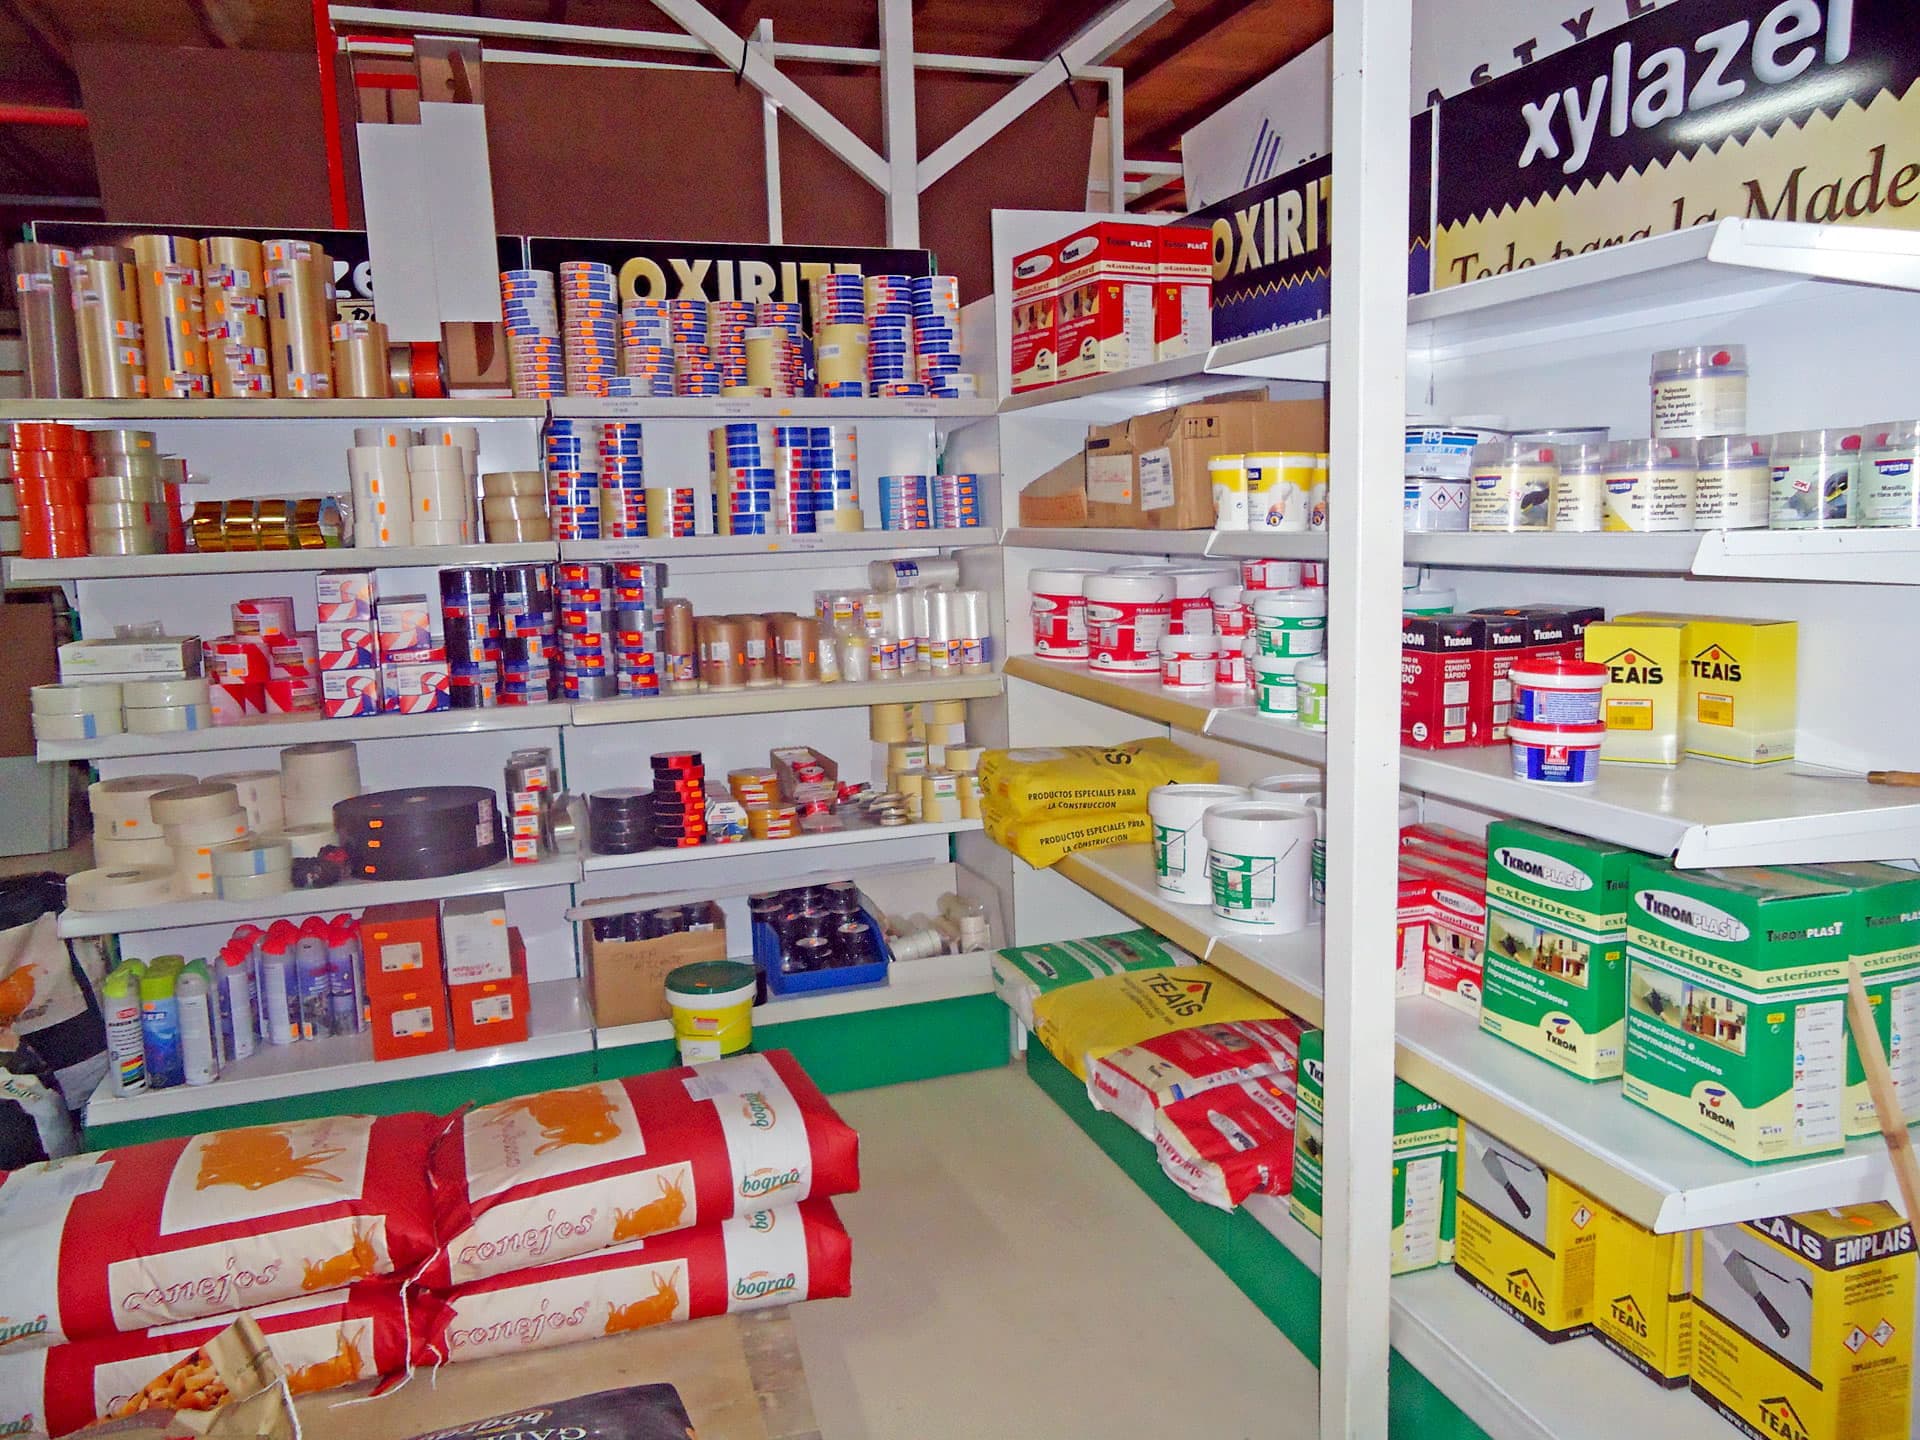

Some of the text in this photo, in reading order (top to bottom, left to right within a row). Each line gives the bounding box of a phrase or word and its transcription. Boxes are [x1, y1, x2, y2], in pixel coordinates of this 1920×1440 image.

[1518, 0, 1852, 174] xylazel
[1444, 663, 1472, 673] CEMENTO
[1691, 660, 1742, 682] TEAIS
[1028, 788, 1137, 801] PRODUCTOS ESPECIALES PARA
[1058, 801, 1117, 810] CONSTRUCCION
[1040, 819, 1145, 846] PRODUCTOS ESPECIALES PARA
[1073, 833, 1128, 850] CONSTRUCCION
[1502, 849, 1586, 890] TKROMPLAST
[1496, 884, 1587, 923] exteriores
[1644, 892, 1741, 941] TKROMPLAST
[1767, 921, 1843, 943] TKROMPLAST
[1637, 934, 1744, 979] exteriores
[1766, 966, 1841, 985] exteriores
[1142, 972, 1204, 1018] TEAIS
[1546, 1030, 1578, 1054] TKROM
[1698, 1101, 1736, 1130] TKROM
[458, 1209, 594, 1267] conejos
[1835, 1226, 1912, 1267] EMPLAIS
[123, 1257, 280, 1314] conejos
[1505, 1277, 1546, 1317] TEAIS
[450, 1300, 588, 1347] conejos
[1610, 1303, 1648, 1339] TEAIS
